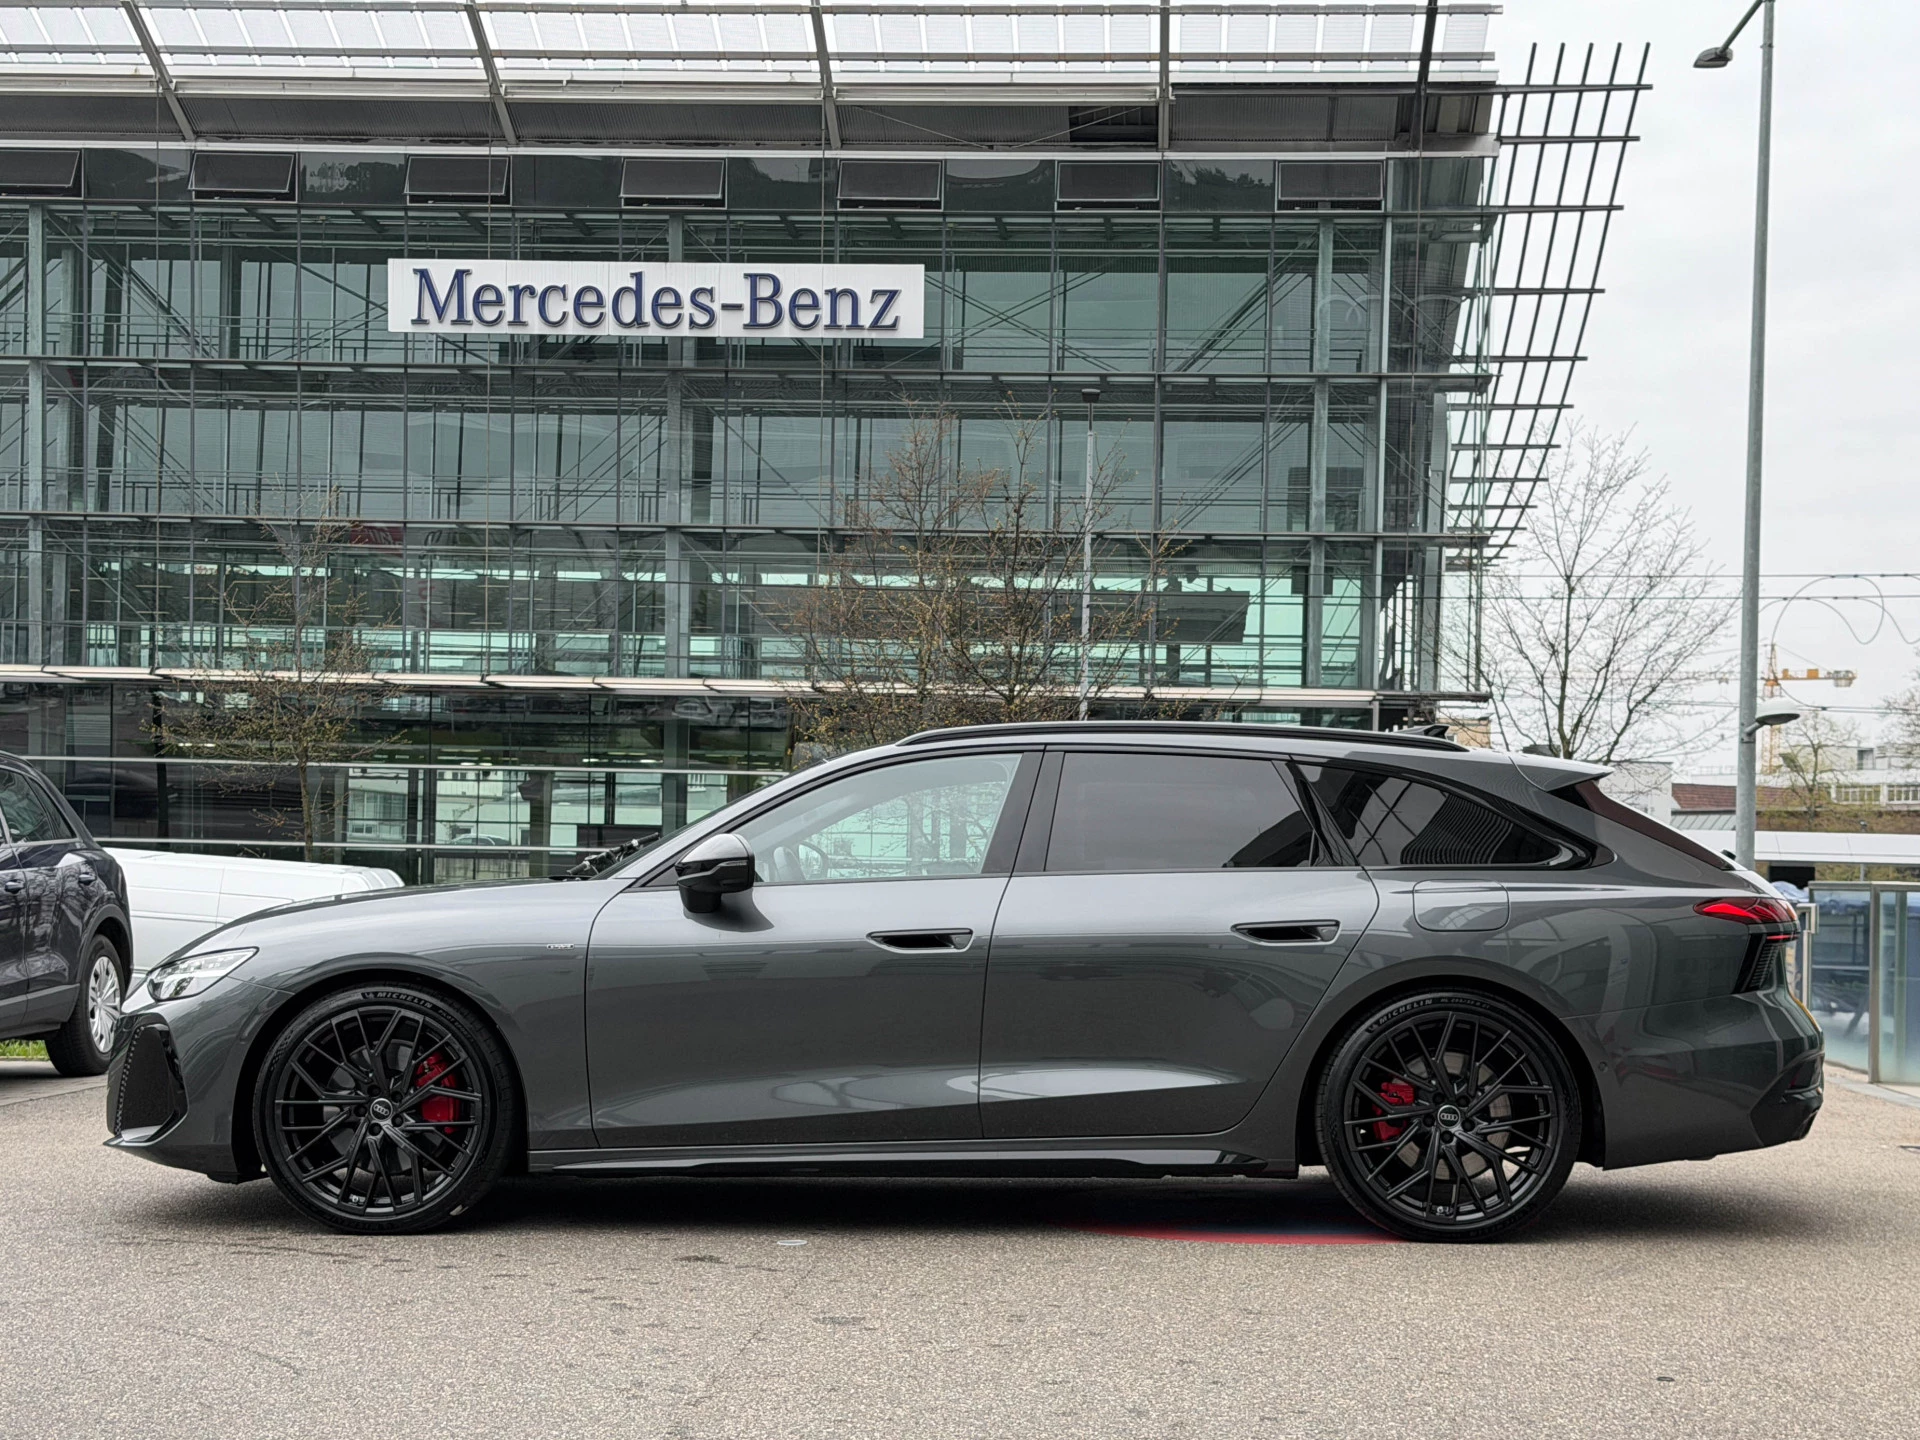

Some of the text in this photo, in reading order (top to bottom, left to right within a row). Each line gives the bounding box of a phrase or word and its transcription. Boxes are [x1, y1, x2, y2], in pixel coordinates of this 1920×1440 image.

[410, 268, 902, 331] Mercedes-Benz
[377, 992, 433, 1009] MICHELIN
[1379, 998, 1433, 1025] MICHELIN
